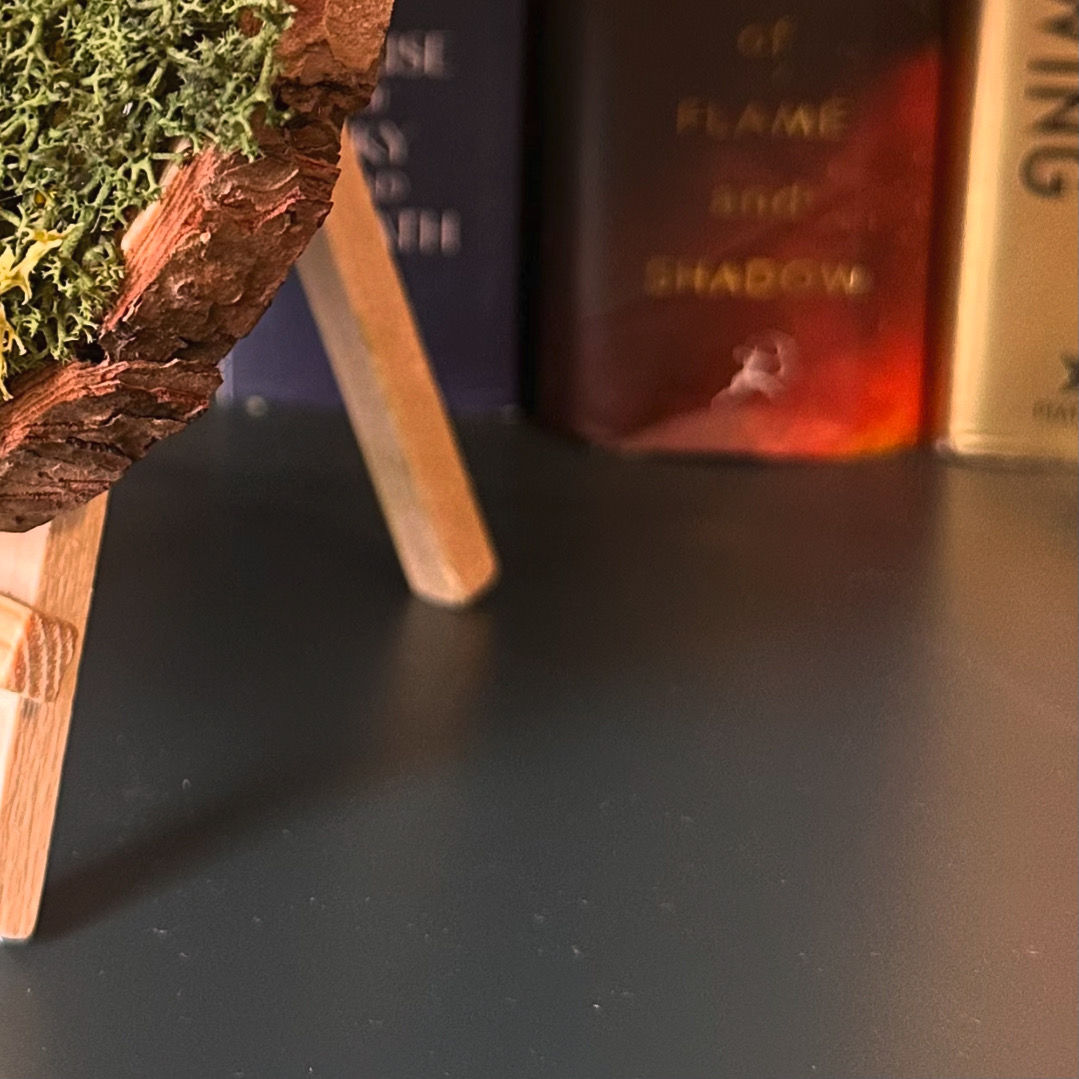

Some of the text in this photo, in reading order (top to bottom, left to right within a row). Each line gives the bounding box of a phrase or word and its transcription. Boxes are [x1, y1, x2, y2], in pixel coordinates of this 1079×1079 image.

[736, 14, 797, 59] of
[676, 95, 853, 142] FLAME
[709, 182, 816, 219] and
[644, 254, 872, 300] SHADOW
